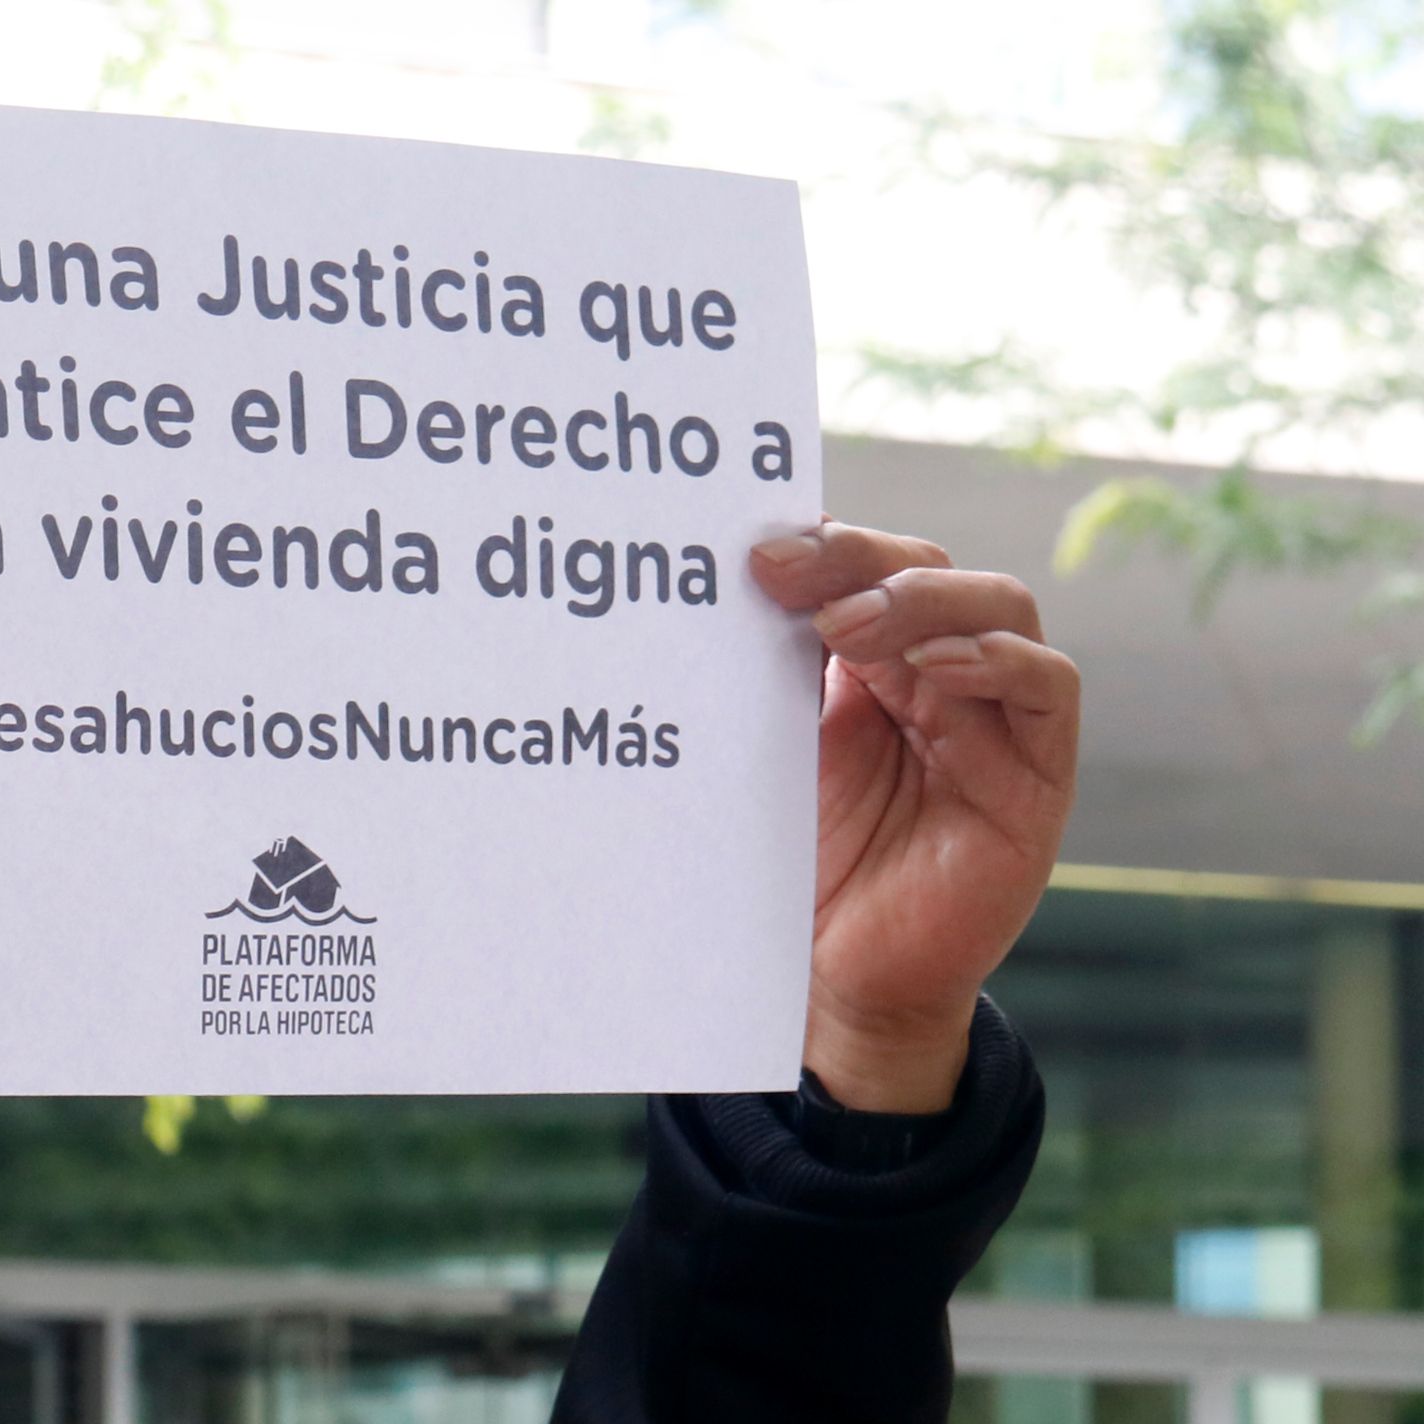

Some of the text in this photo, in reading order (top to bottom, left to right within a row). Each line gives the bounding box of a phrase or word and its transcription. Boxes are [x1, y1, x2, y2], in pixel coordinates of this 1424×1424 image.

[197, 233, 547, 339] Justicia
[578, 279, 738, 362] que
[230, 369, 308, 456] el
[344, 377, 721, 478] Derecho
[750, 420, 794, 483] a
[40, 493, 440, 596] vivienda
[474, 514, 719, 619] digna
[201, 933, 378, 967] PLATAFORMA
[200, 1009, 375, 1036] POR LA HIPOTECA
[201, 972, 377, 1003] DE AFECTADOS
